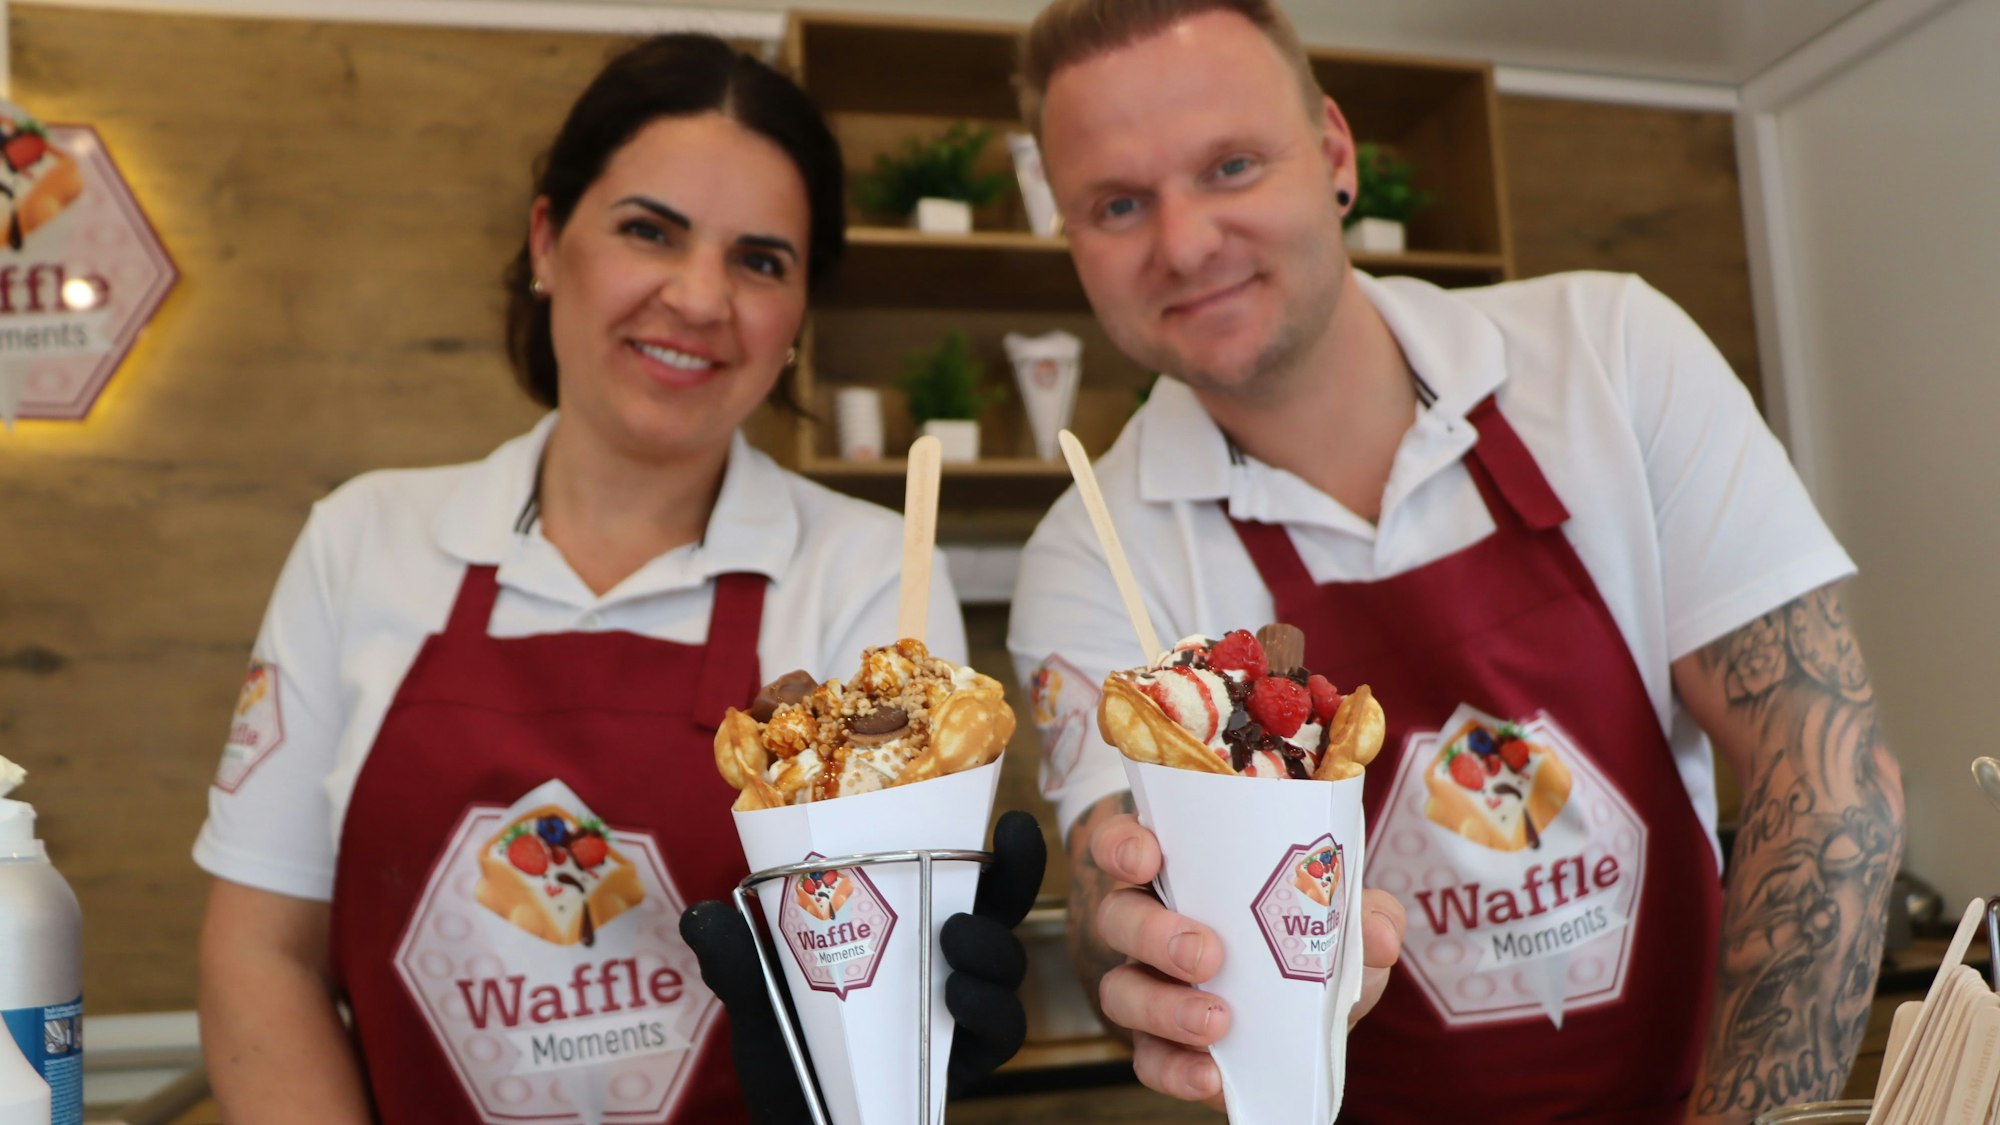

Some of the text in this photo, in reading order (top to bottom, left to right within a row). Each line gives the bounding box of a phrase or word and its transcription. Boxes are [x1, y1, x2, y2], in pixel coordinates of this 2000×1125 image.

[1414, 853, 1620, 935] Waffle
[797, 922, 871, 950] Waffle
[819, 945, 865, 963] Moments
[1492, 905, 1608, 961] Moments
[456, 957, 684, 1029] Waffle
[531, 1021, 666, 1065] Moments
